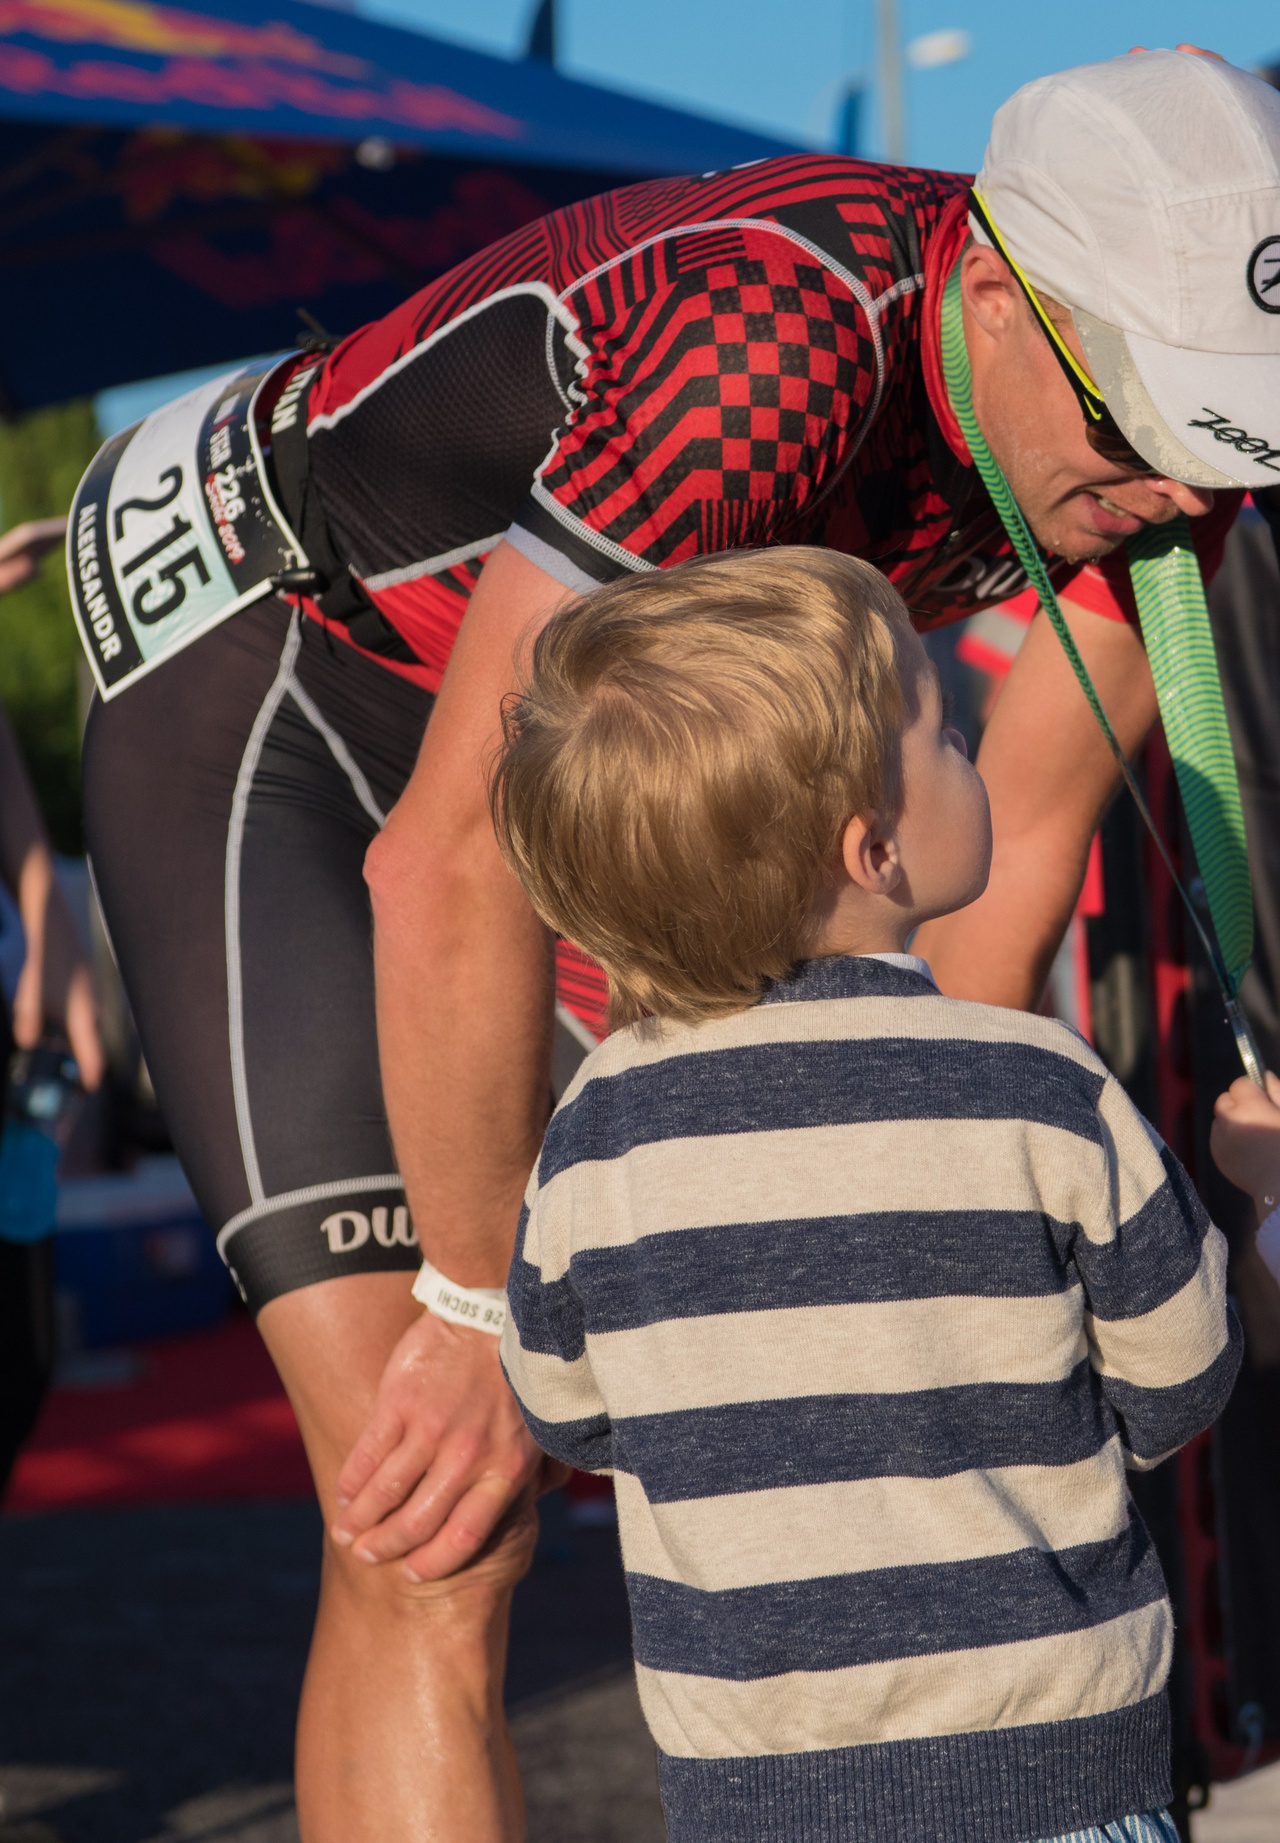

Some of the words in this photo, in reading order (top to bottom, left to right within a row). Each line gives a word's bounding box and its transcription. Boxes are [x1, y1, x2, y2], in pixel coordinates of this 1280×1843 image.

[214, 463, 246, 523] 226
[113, 463, 211, 625] 215
[219, 523, 246, 560] 2019
[77, 502, 122, 663] ALEKSANDR
[438, 1288, 480, 1320] SOCHI
